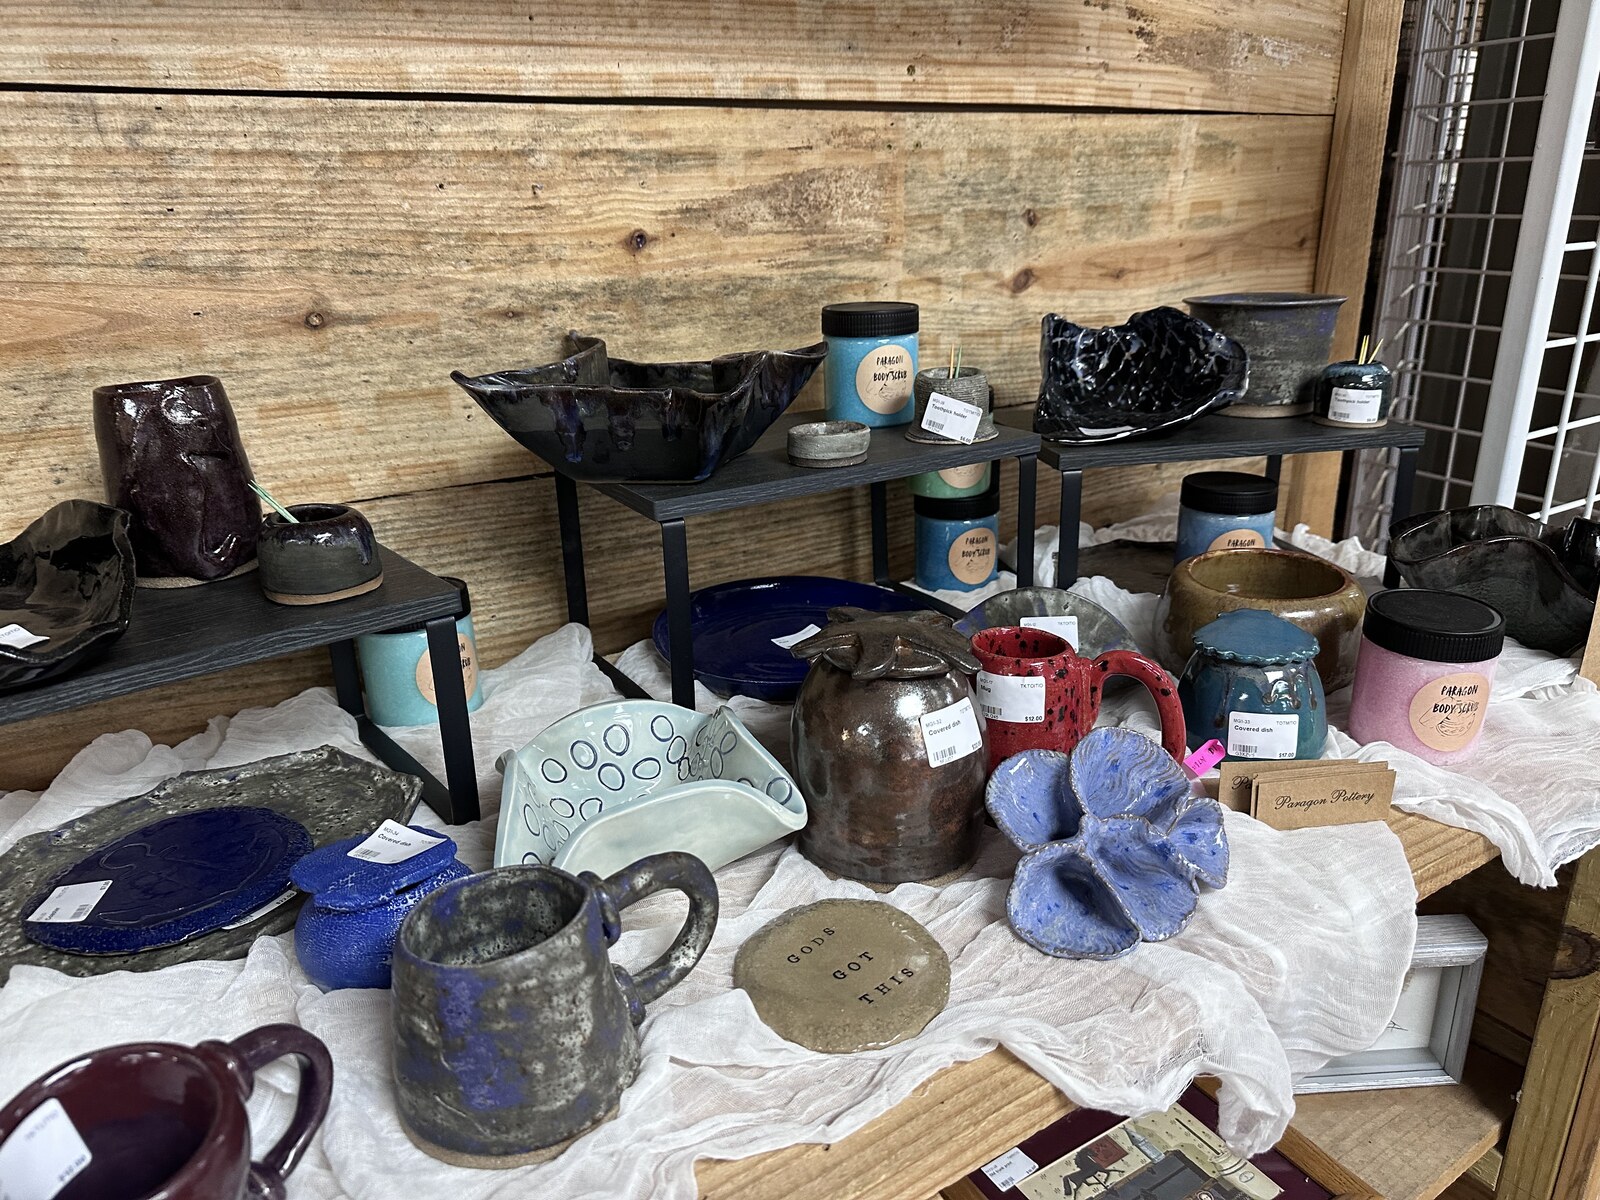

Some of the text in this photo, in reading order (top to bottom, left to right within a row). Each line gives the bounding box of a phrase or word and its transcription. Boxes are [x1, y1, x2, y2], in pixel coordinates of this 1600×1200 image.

[876, 354, 904, 366] PARAGON
[873, 369, 908, 382] BODY SCRUB
[965, 535, 989, 545] PARAGON
[1227, 538, 1256, 548] PARAGON
[961, 547, 991, 559] BODY SCRUB
[1440, 684, 1479, 697] PARAGON
[1432, 701, 1480, 714] BODY SCRUB
[928, 719, 961, 735] Covered dish
[1234, 724, 1260, 733] Covered
[1278, 751, 1295, 759] $17.00
[1274, 788, 1376, 812] Paragon Pottery
[378, 833, 400, 845] Covered
[787, 927, 835, 964] GODS
[832, 951, 874, 980] GOT
[858, 967, 915, 1005] THIS
